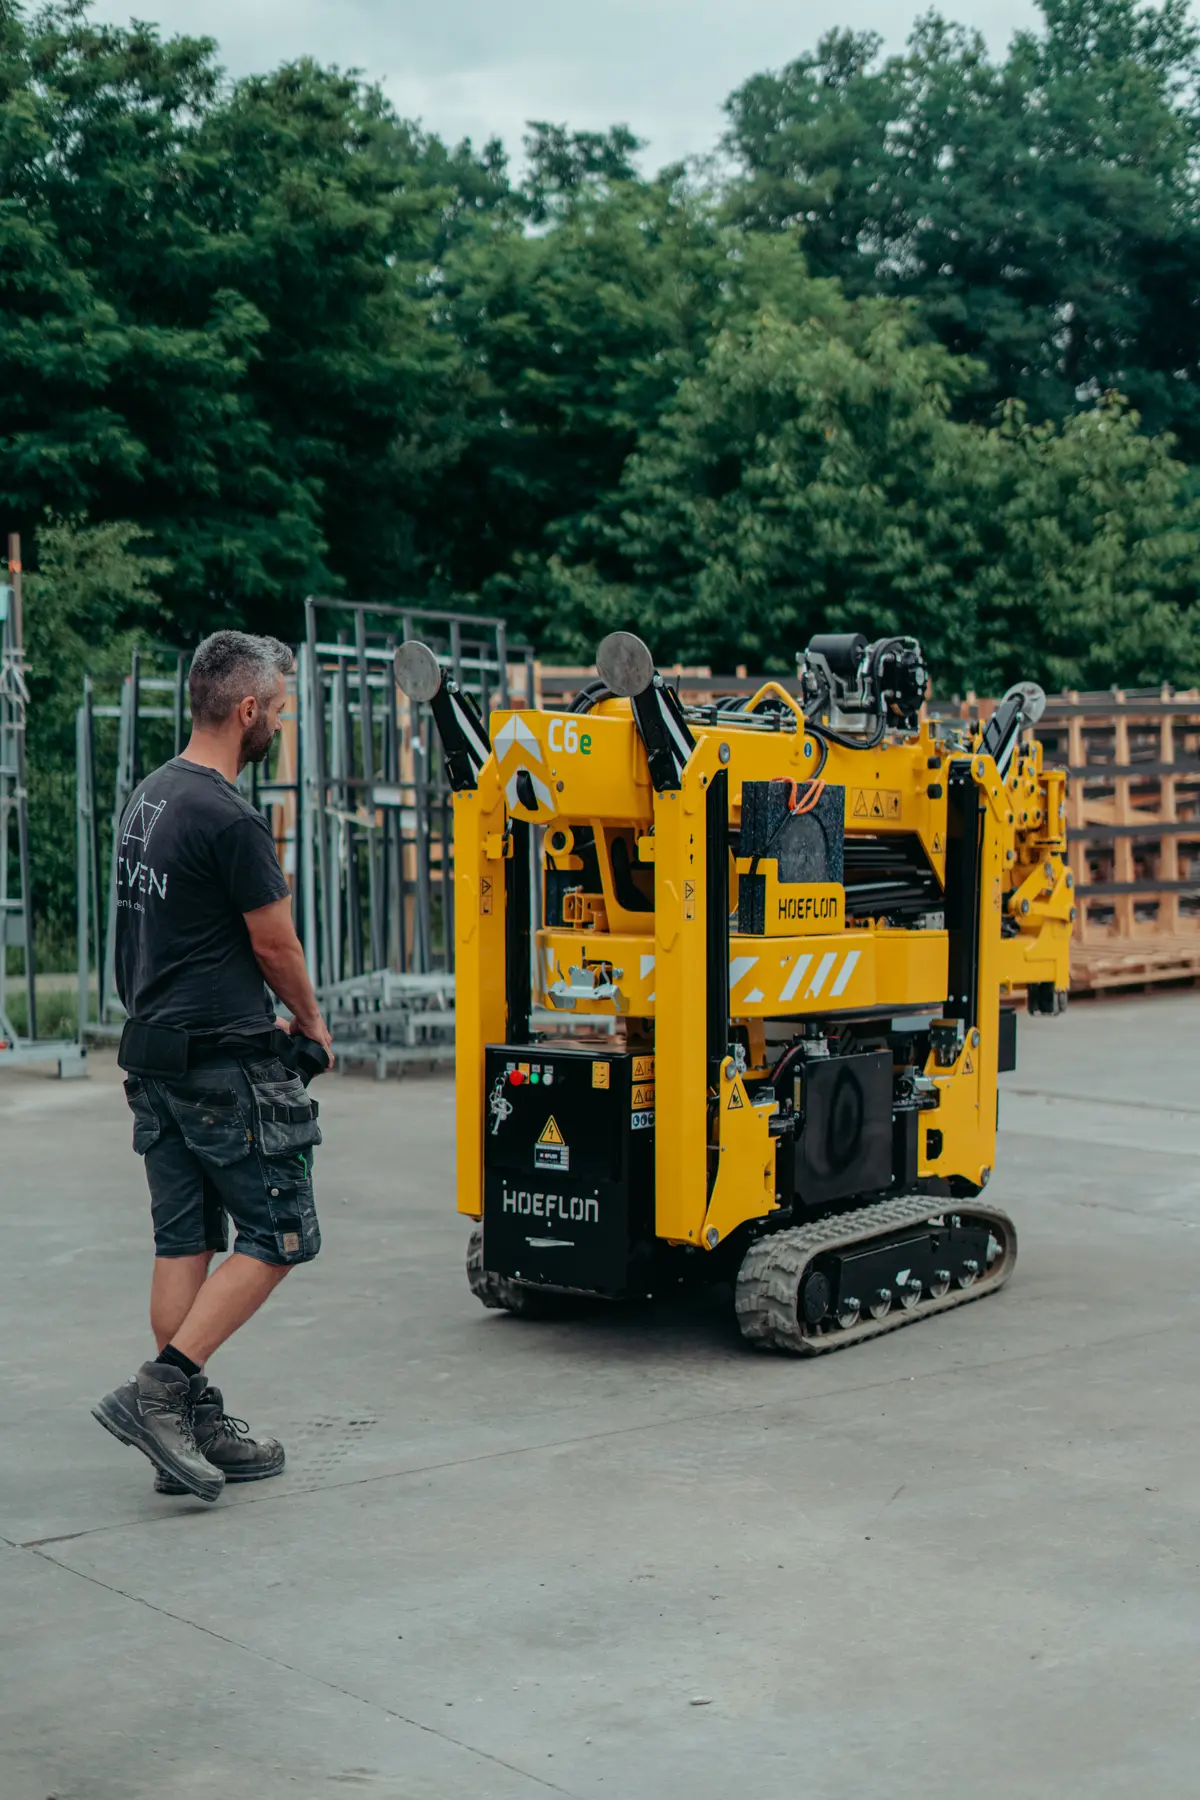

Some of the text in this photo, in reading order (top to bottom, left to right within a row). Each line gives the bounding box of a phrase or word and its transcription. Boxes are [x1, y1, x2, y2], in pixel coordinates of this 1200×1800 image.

[548, 718, 592, 755] C6e
[778, 897, 837, 919] HOEFLON
[503, 1189, 599, 1223] HOEFLON
